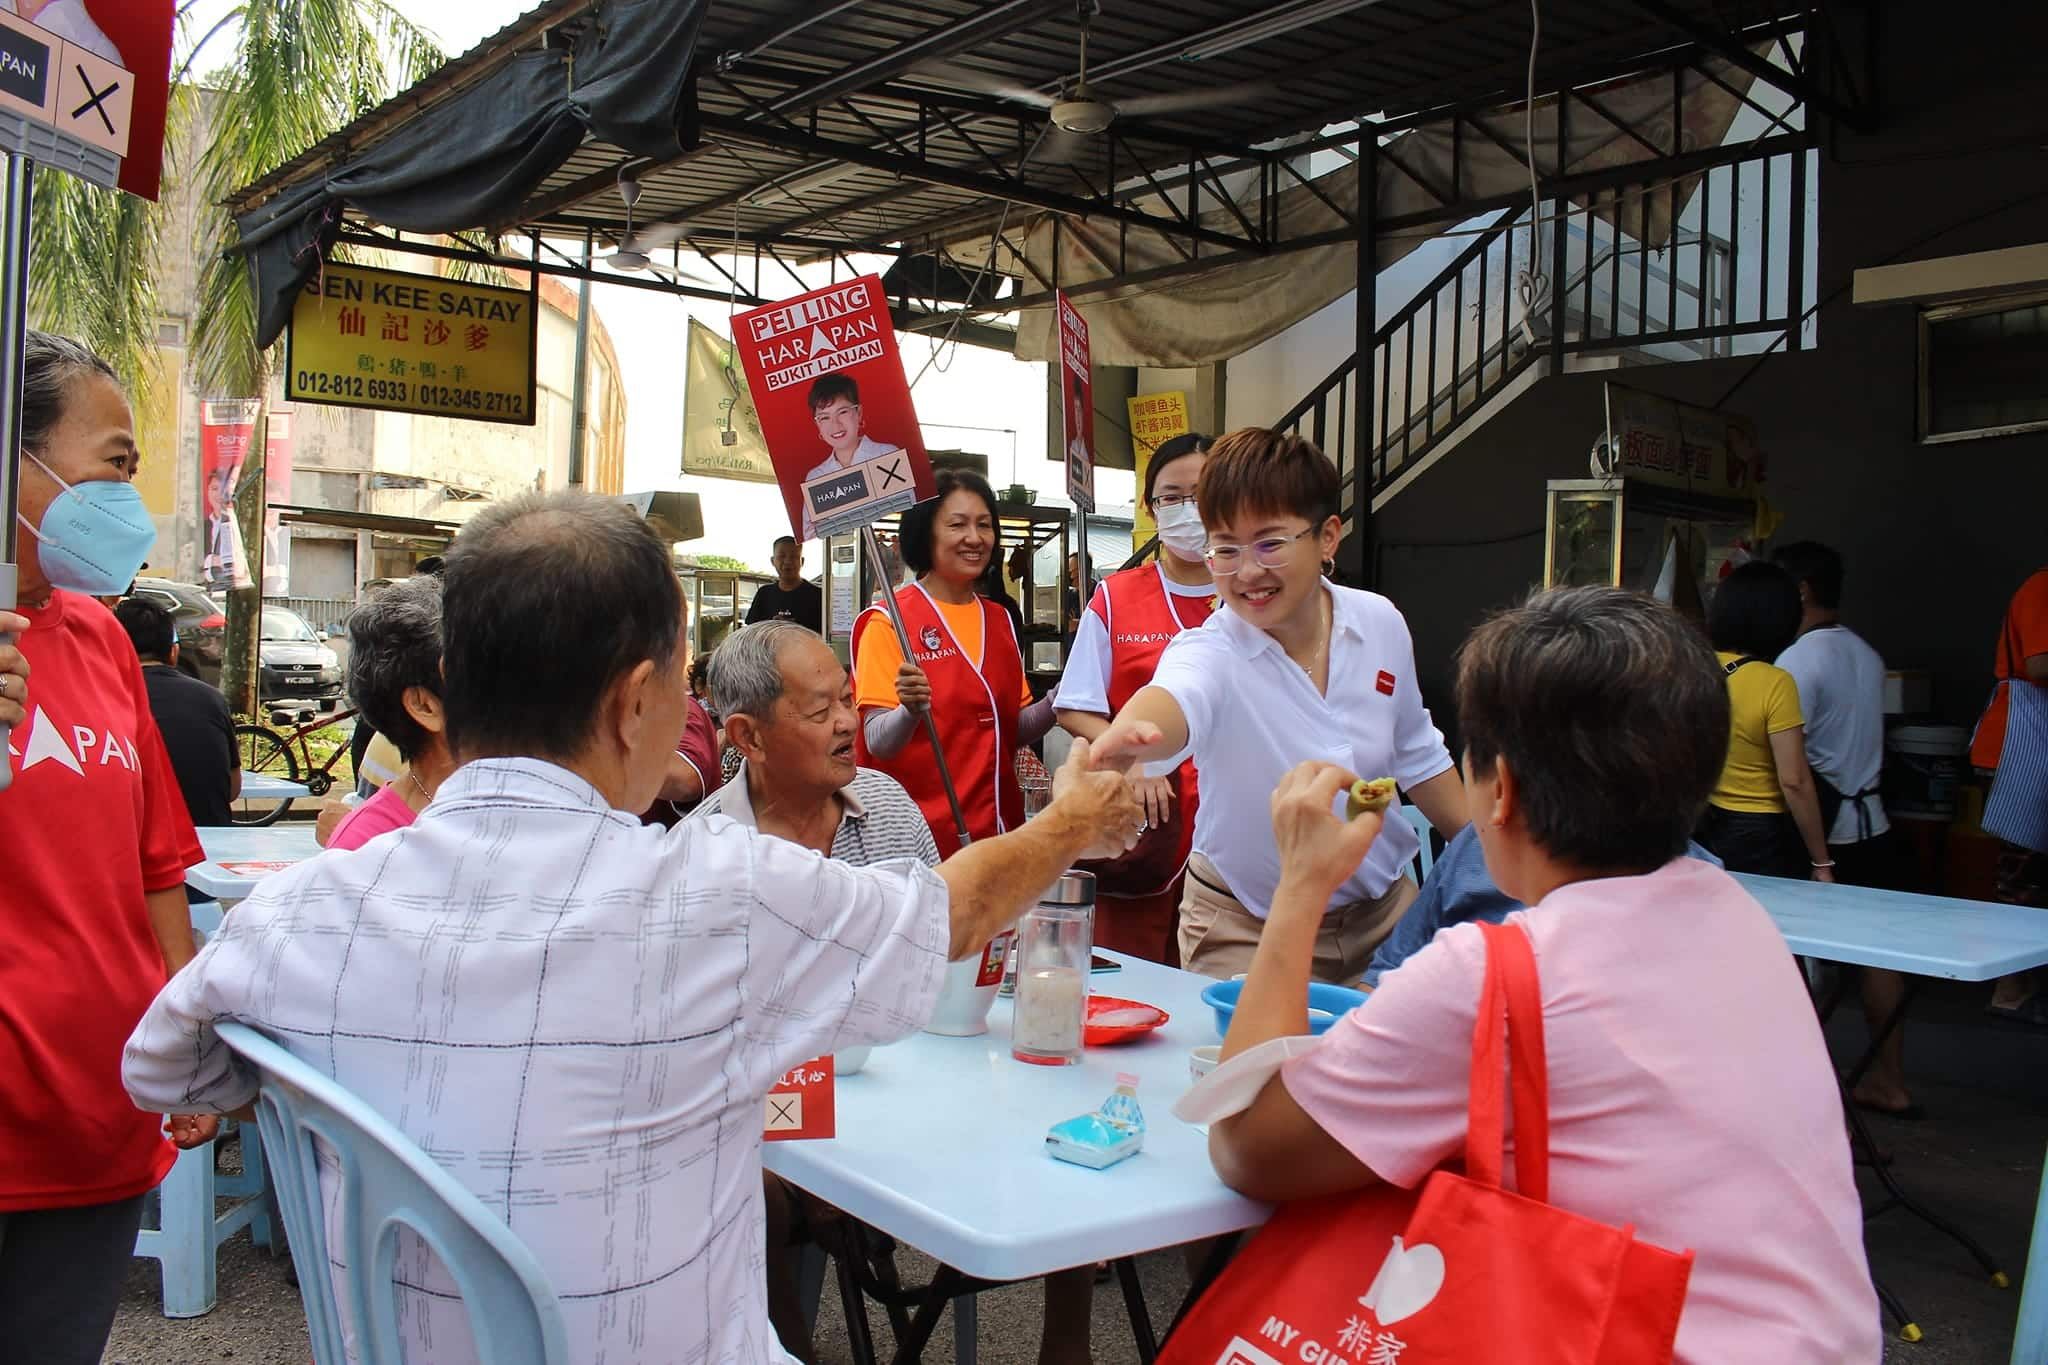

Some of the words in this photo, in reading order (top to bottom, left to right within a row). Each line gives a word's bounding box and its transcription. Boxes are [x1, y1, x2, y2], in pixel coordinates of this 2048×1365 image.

[0, 50, 36, 80] PAN
[373, 282, 430, 311] KEE
[437, 291, 521, 323] SATAY
[751, 308, 795, 340] PEI
[802, 286, 868, 324] LING
[338, 306, 491, 351] 仙記沙爹
[757, 314, 878, 369] HARAPAN
[767, 362, 815, 389] BUKIT
[818, 341, 881, 372] LANJAN
[298, 370, 362, 397] 012-812
[368, 379, 407, 401] 6933
[420, 385, 481, 410] 012-345
[486, 391, 522, 414] 2712
[816, 482, 861, 503] HARAPAN
[1117, 633, 1172, 643] HARAPAN
[1259, 1315, 1300, 1348] MY
